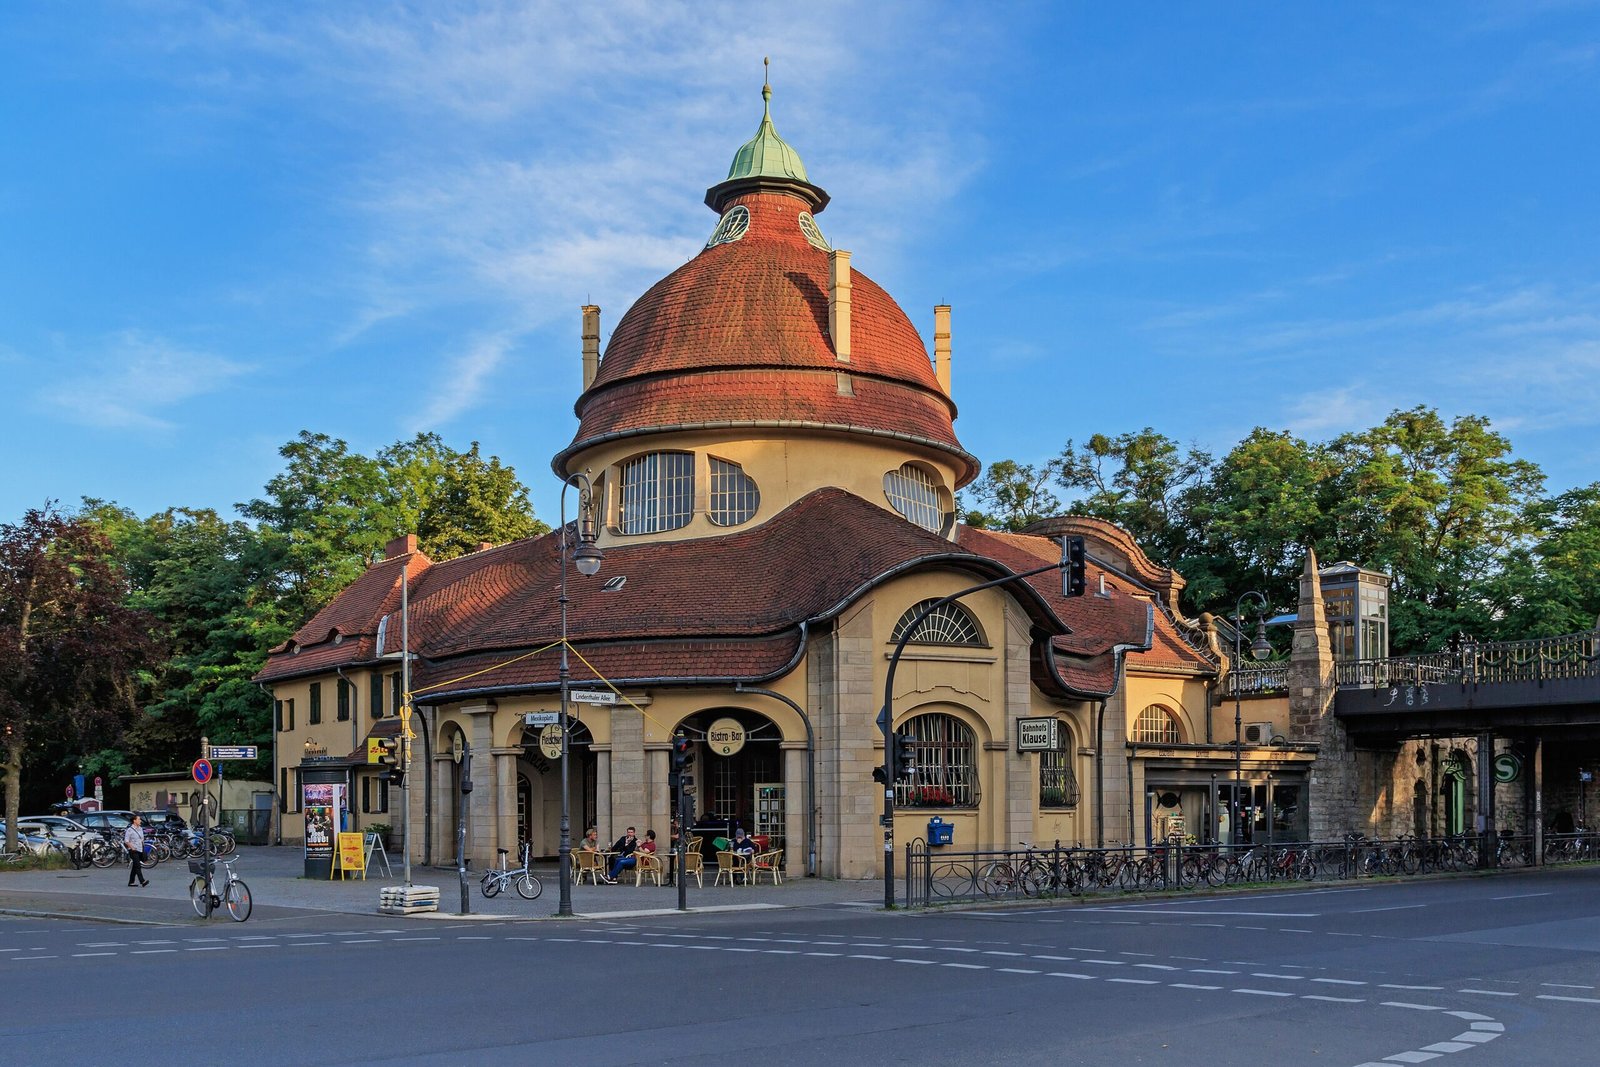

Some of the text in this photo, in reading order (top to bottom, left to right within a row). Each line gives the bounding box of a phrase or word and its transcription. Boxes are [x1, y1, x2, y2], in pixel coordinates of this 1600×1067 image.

[575, 693, 600, 701] Lindenthaler
[530, 714, 554, 723] Mexikoplatz
[1022, 724, 1047, 732] Bahnhofs
[711, 731, 742, 741] Bistro Bar
[1022, 733, 1047, 744] Klause
